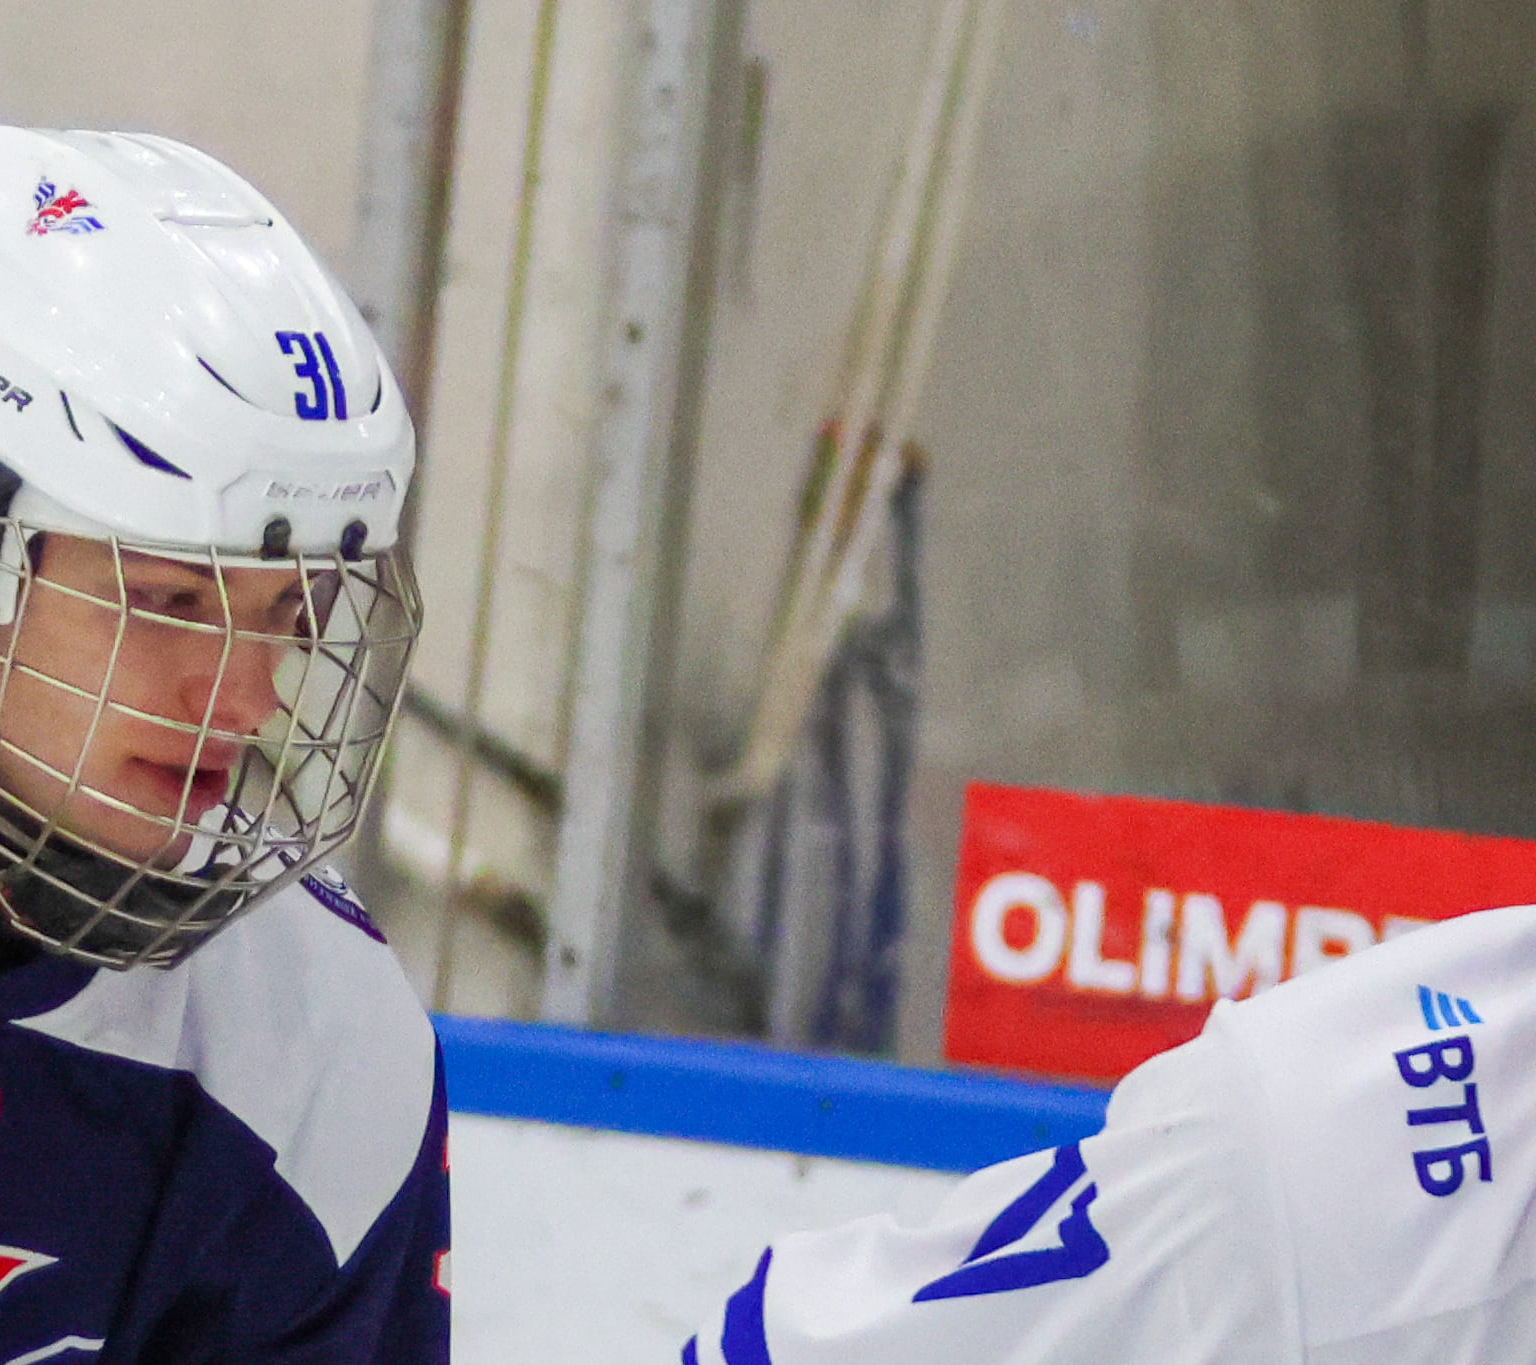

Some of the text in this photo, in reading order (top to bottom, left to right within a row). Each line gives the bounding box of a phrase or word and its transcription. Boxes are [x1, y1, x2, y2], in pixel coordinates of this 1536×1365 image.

[275, 331, 348, 421] 31
[970, 871, 1442, 1000] OLIMP
[1392, 1035, 1493, 1197] ВТБ
